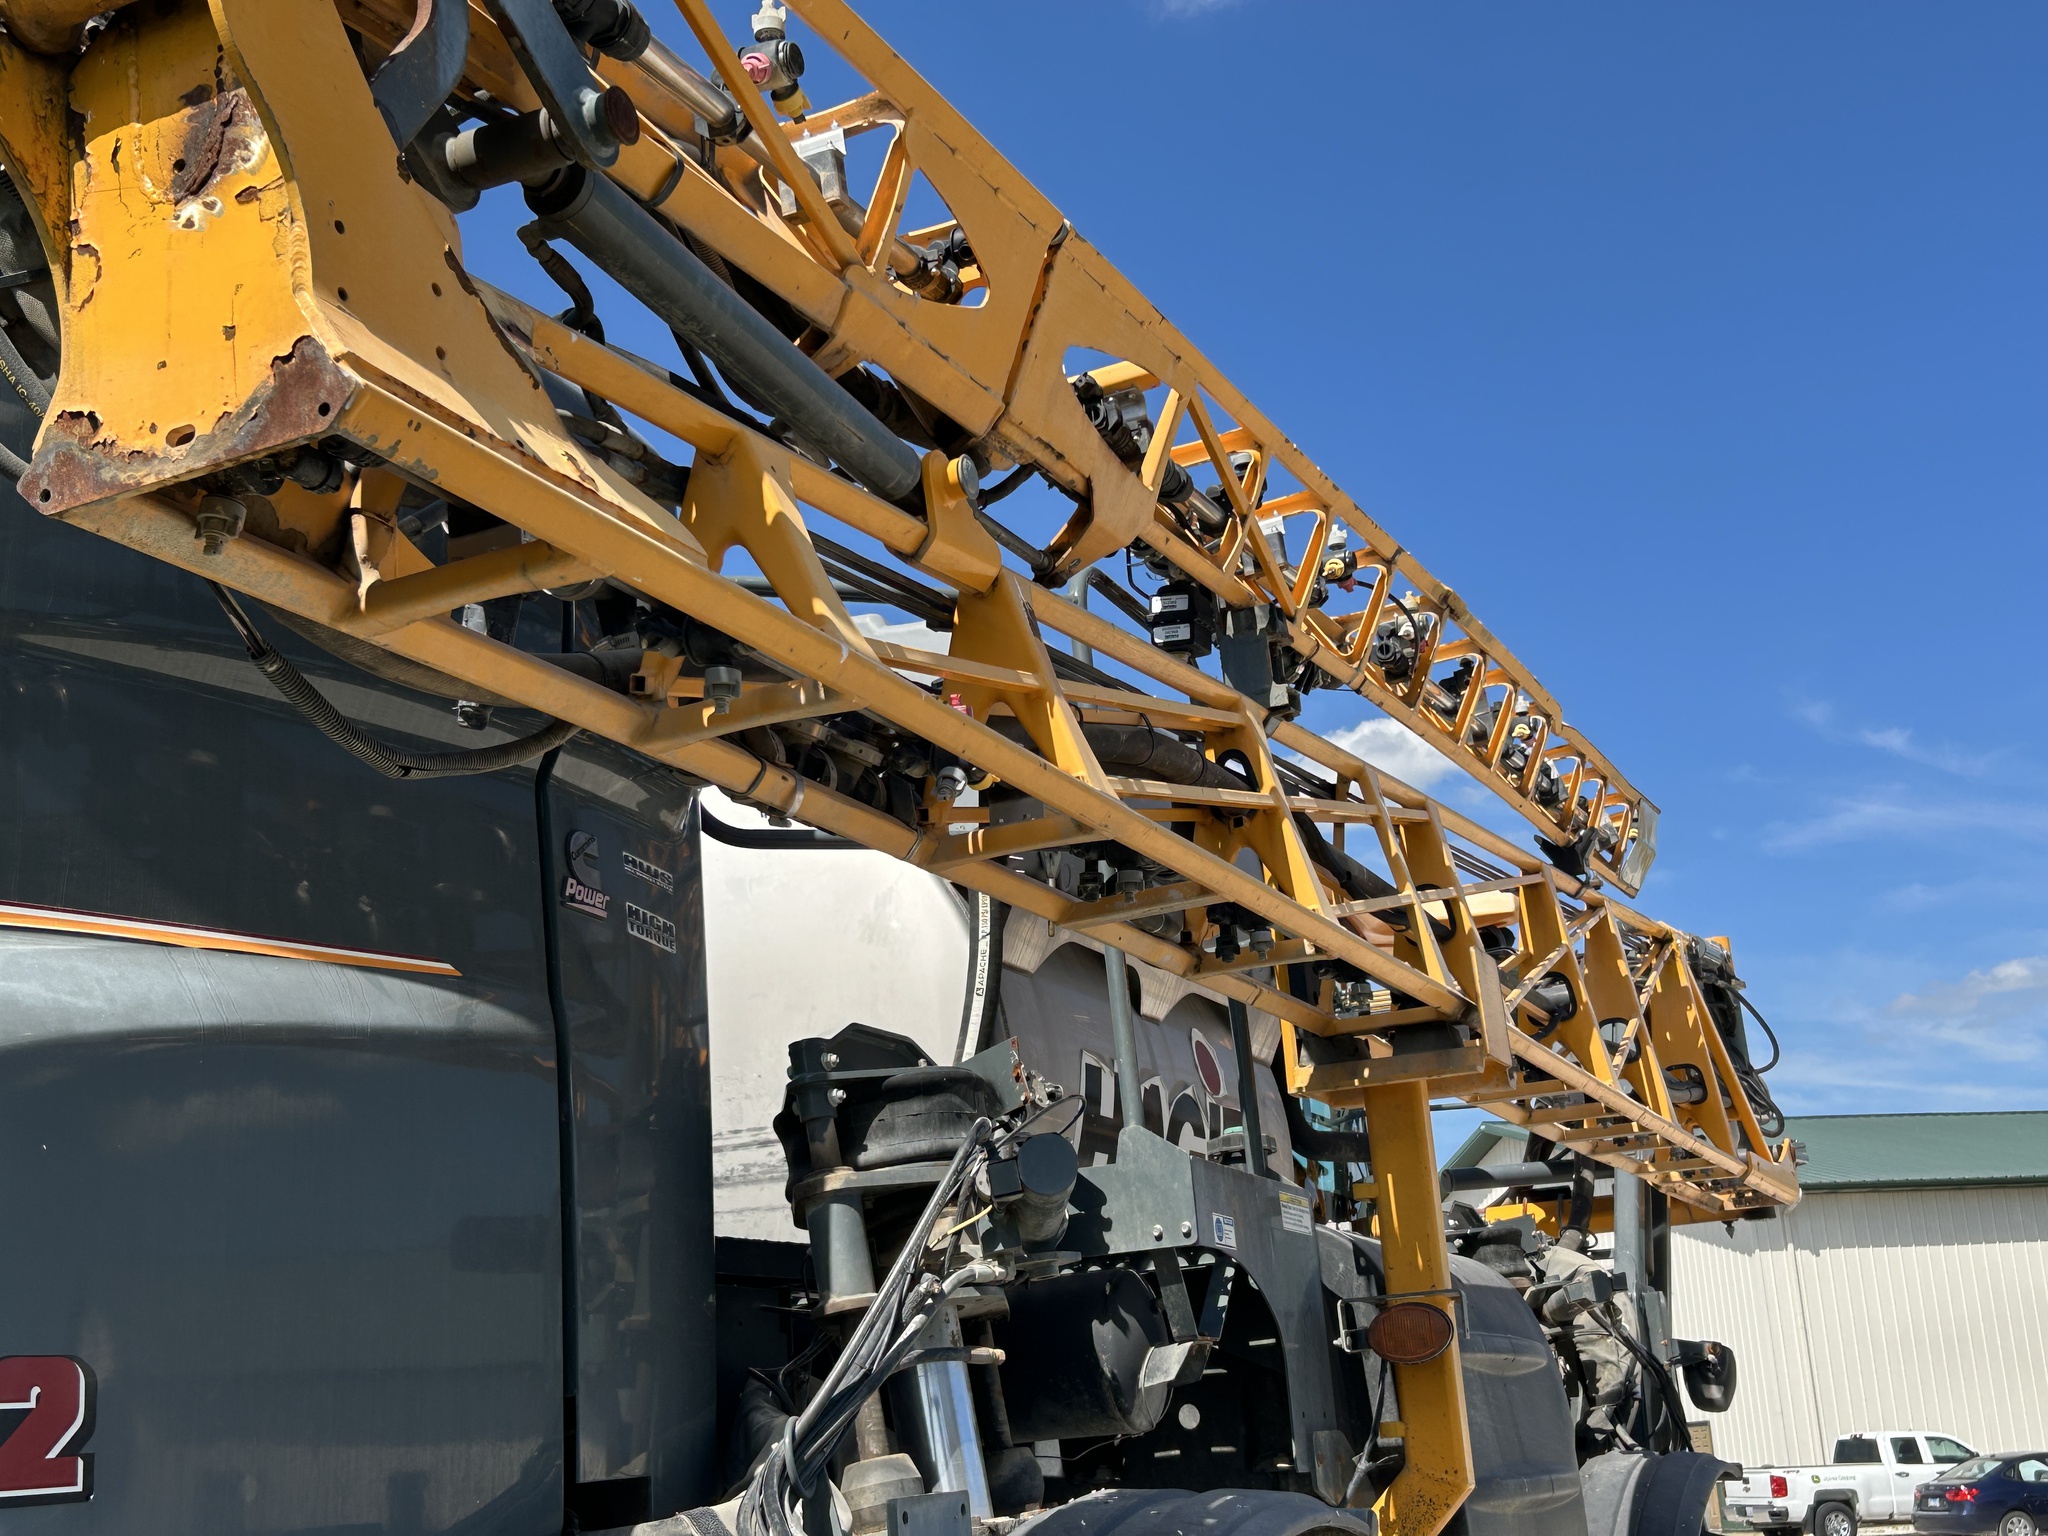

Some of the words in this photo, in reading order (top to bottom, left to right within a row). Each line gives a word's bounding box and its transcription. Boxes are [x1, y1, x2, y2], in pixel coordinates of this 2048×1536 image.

[627, 904, 675, 938] HIGH
[628, 920, 677, 952] TORQUE
[977, 949, 988, 986] APACHE
[0, 1355, 98, 1509] 2
